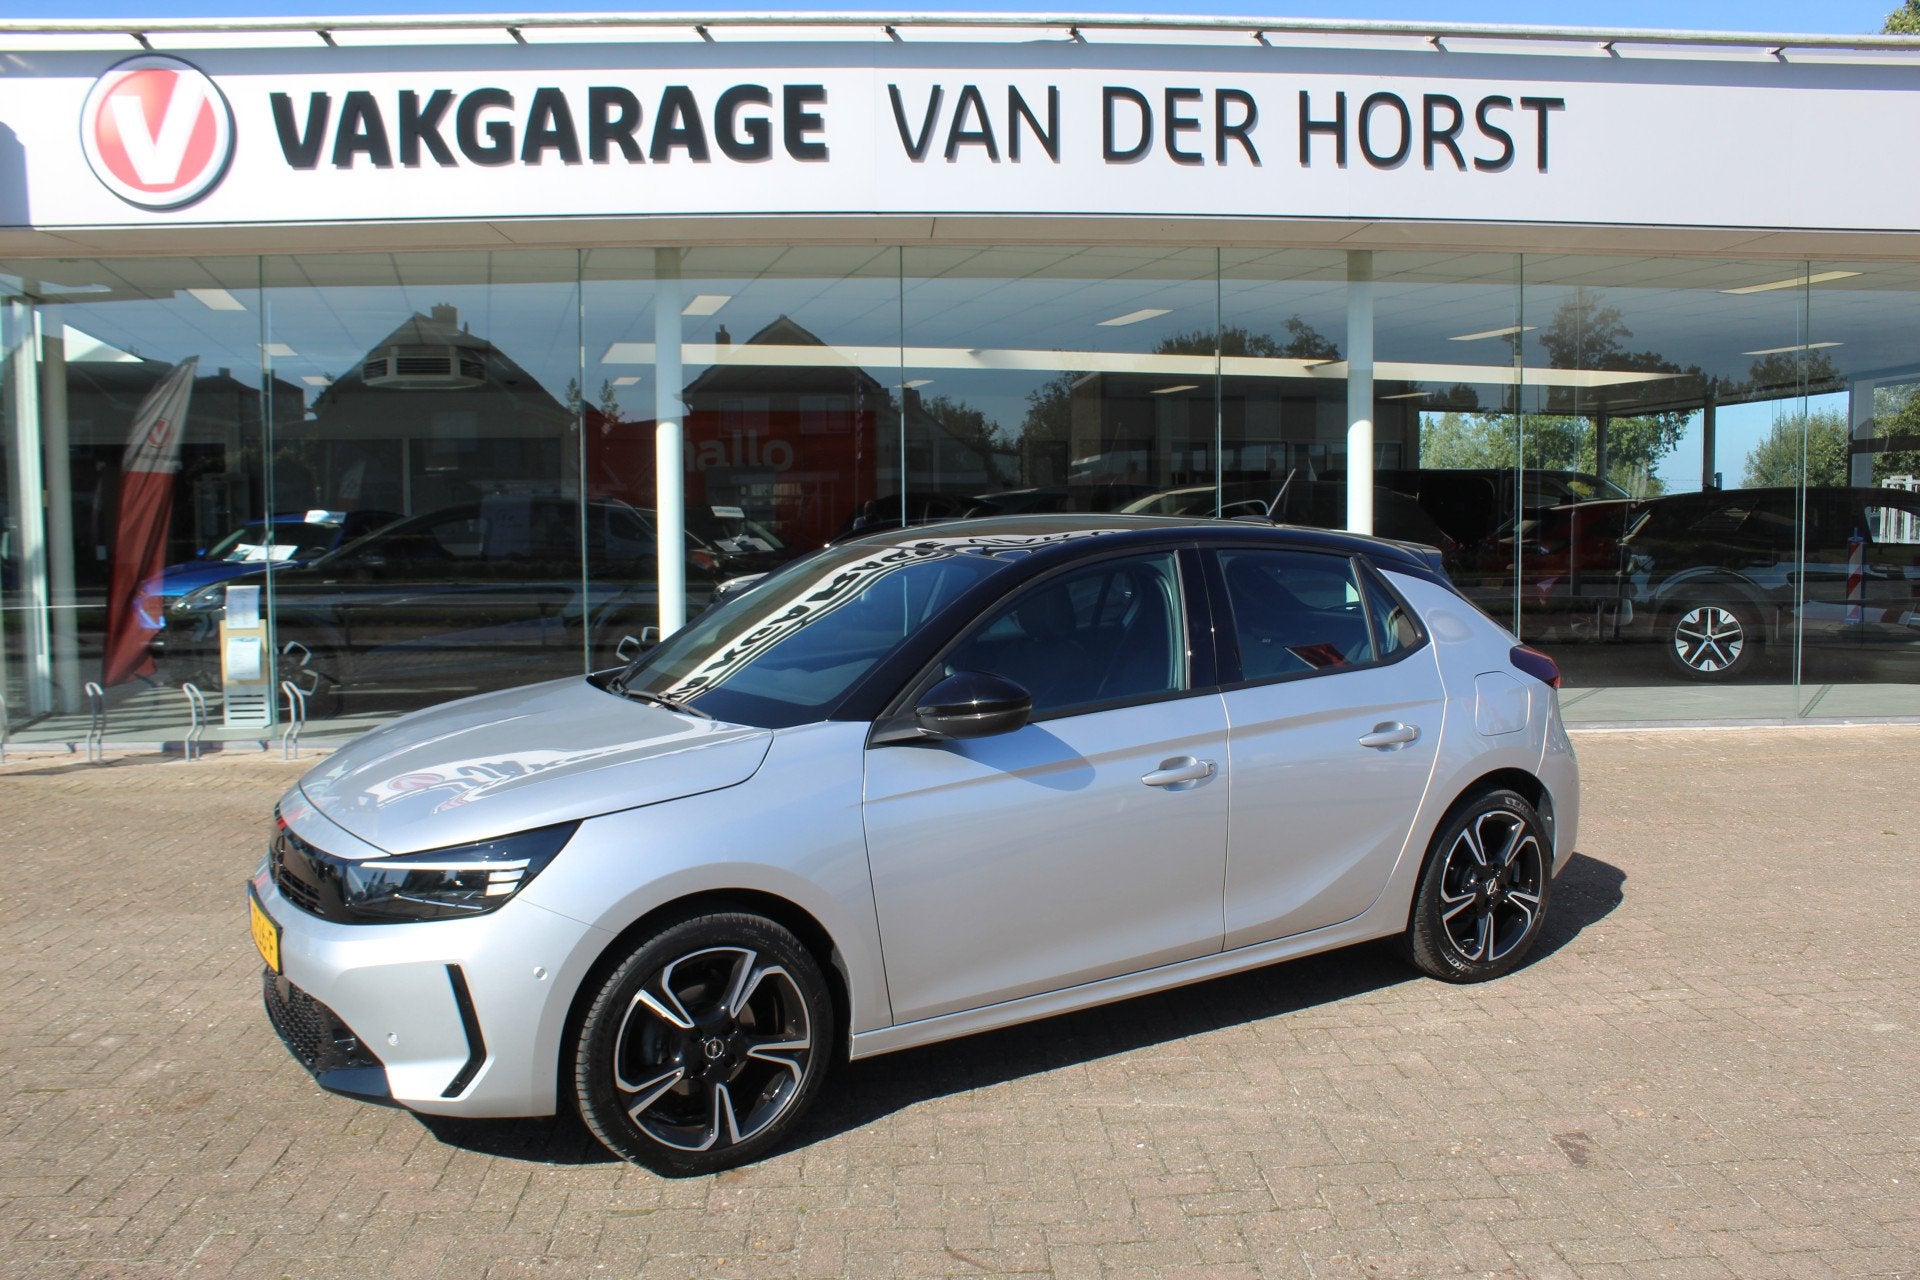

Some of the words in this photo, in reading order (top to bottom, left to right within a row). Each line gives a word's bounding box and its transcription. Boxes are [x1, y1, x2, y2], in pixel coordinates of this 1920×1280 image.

[108, 68, 208, 186] V
[270, 84, 828, 168] VAKGARAGE
[888, 84, 1058, 161] VAN
[1102, 86, 1260, 165] DER
[1299, 90, 1565, 170] HORST
